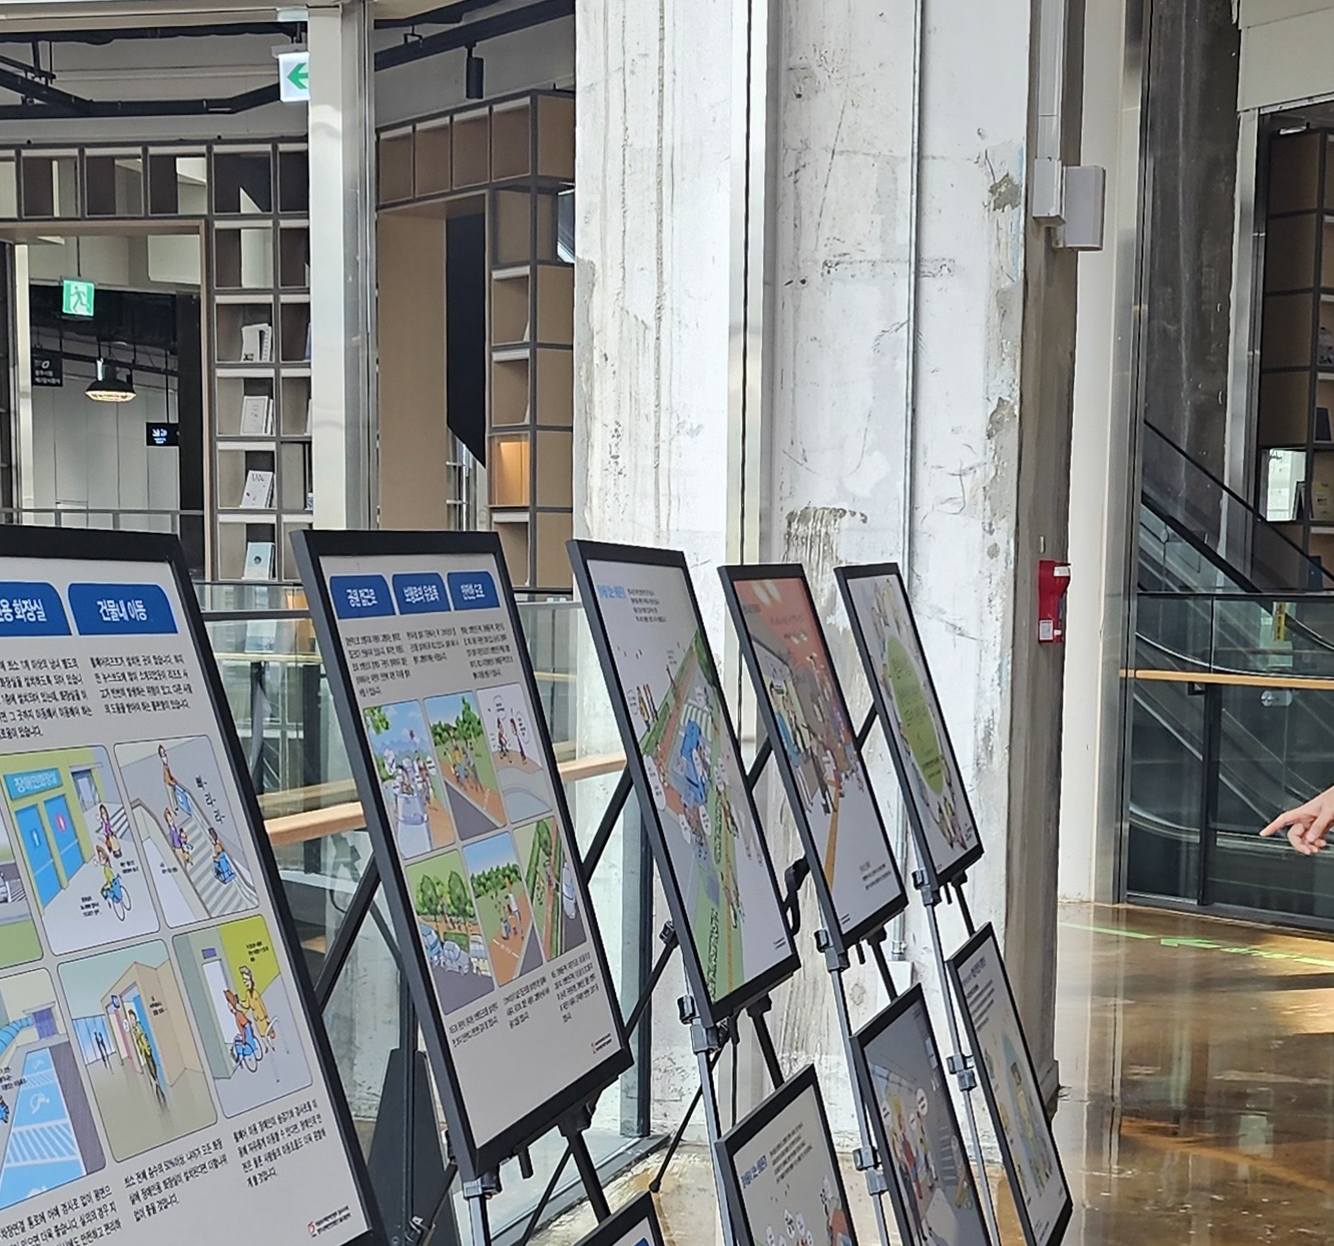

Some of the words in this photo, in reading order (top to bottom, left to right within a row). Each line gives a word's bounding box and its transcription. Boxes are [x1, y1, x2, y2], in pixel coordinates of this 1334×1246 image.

[13, 599, 47, 624] 화장실
[97, 599, 128, 623] 건물내
[128, 599, 147, 622] 이동
